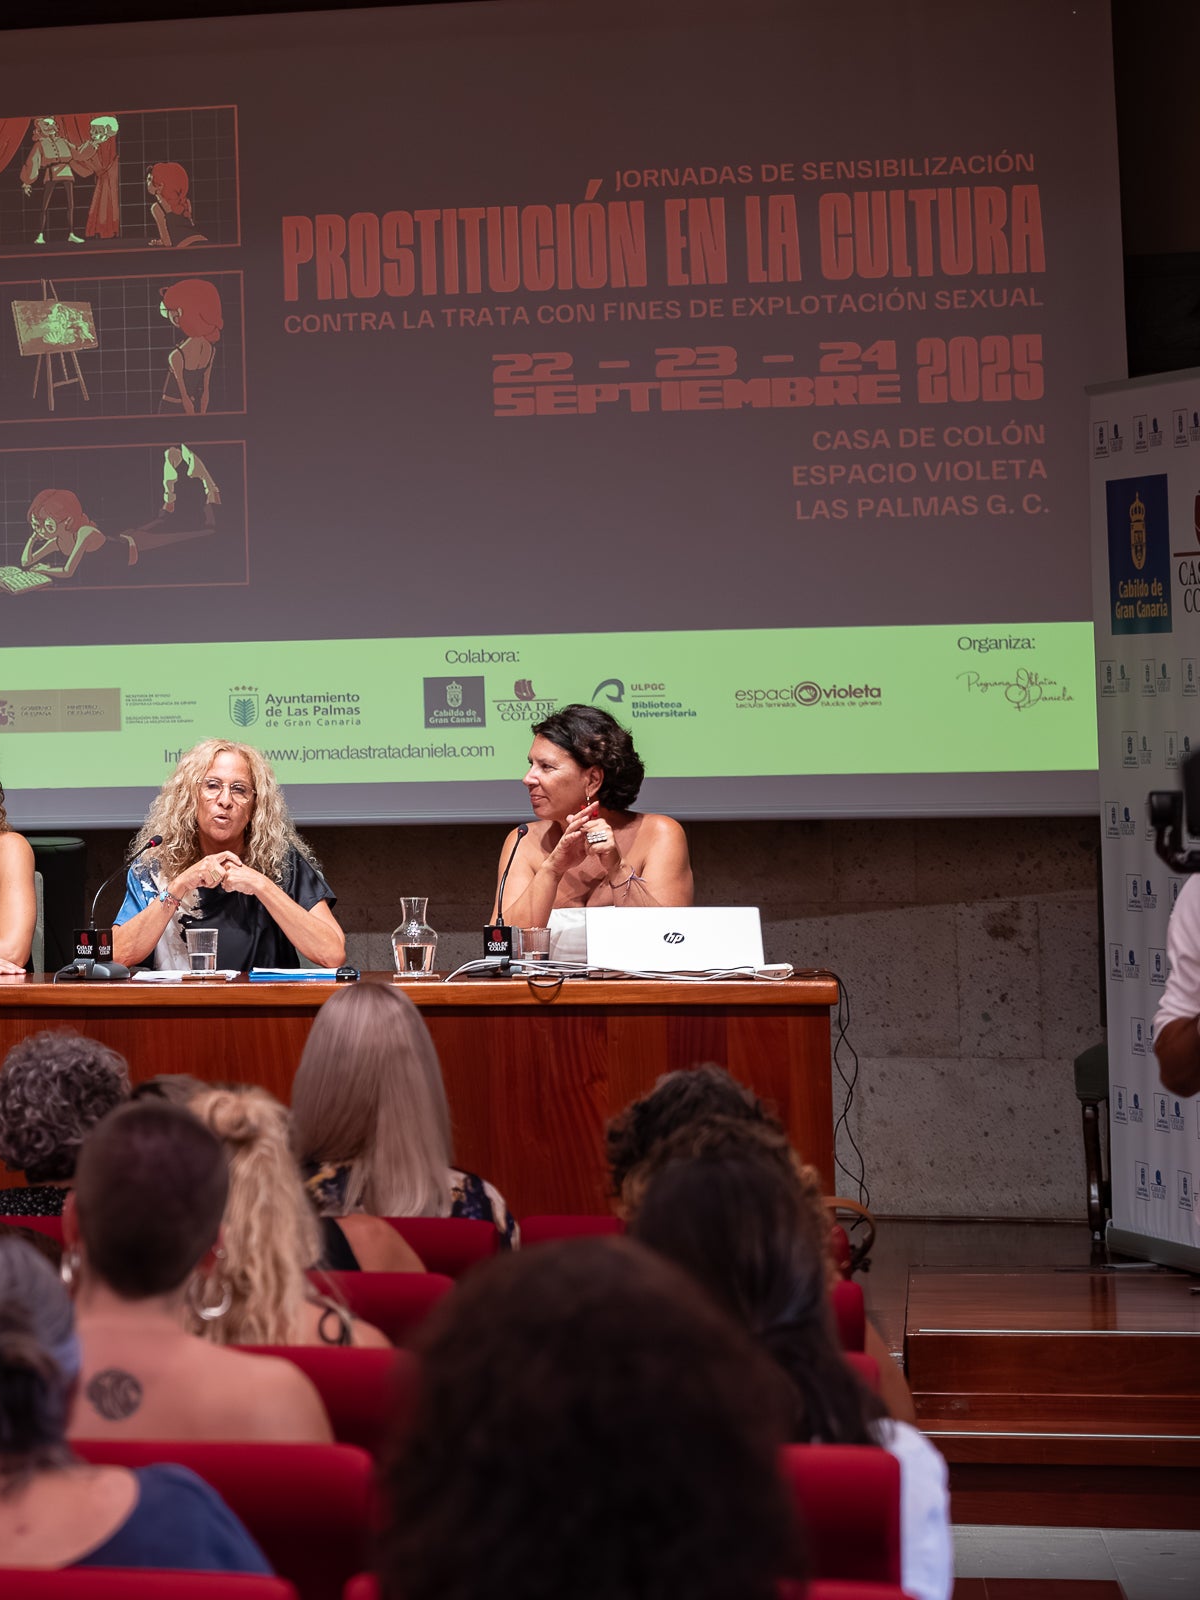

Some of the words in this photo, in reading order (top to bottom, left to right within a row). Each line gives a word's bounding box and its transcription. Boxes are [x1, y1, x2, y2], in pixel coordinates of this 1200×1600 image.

[615, 164, 753, 192] JORNADAS
[761, 162, 795, 183] DE
[801, 149, 1035, 181] SENSIBILIZACIÓN
[282, 178, 648, 302] PROSTITUCIÓN
[664, 197, 728, 286] EN
[745, 194, 802, 283] LA
[818, 184, 1046, 281] CULTURA
[284, 310, 397, 334] CONTRA
[402, 309, 435, 330] LA
[441, 305, 531, 328] TRATA
[536, 302, 597, 325] CON
[603, 299, 681, 322] FINES
[689, 298, 725, 319] DE
[732, 287, 927, 318] EXPLOTACIÓN
[934, 287, 1044, 310] SEXUAL
[492, 352, 575, 384] 22
[654, 345, 738, 378] 23
[818, 339, 897, 372] 24
[916, 333, 1045, 404] 2025
[493, 374, 901, 417] SEPTIEMBRE
[812, 428, 892, 452] CASA
[899, 427, 936, 448] DE
[943, 419, 1046, 448] COLÓN
[792, 462, 917, 487] ESPACIO
[923, 458, 1049, 483] VIOLETA
[796, 498, 850, 521] LAS
[857, 494, 979, 520] PALMAS
[986, 494, 1015, 515] G.
[1022, 493, 1050, 515] C.
[1118, 578, 1149, 598] Cabildo
[1151, 577, 1163, 597] de
[1115, 601, 1135, 619] Gran
[1136, 598, 1169, 618] Canaria
[957, 634, 1036, 653] Organiza:
[445, 649, 520, 664] Colabora:
[630, 683, 666, 692] ULPGC
[265, 691, 360, 706] Ayuntamiento
[496, 702, 532, 713] CASA
[536, 702, 554, 712] DE
[631, 700, 682, 710] Biblioteca
[265, 705, 284, 718] de
[286, 705, 311, 718] Las
[313, 704, 361, 718] Palmas
[429, 716, 451, 725] Gran
[452, 714, 481, 724] Canaria
[433, 709, 463, 718] Cabildo
[464, 708, 477, 717] de
[631, 709, 697, 718] Universitaria
[265, 719, 280, 728] de
[284, 718, 311, 728] Gran
[317, 717, 362, 727] Canaria
[663, 931, 685, 944] hp
